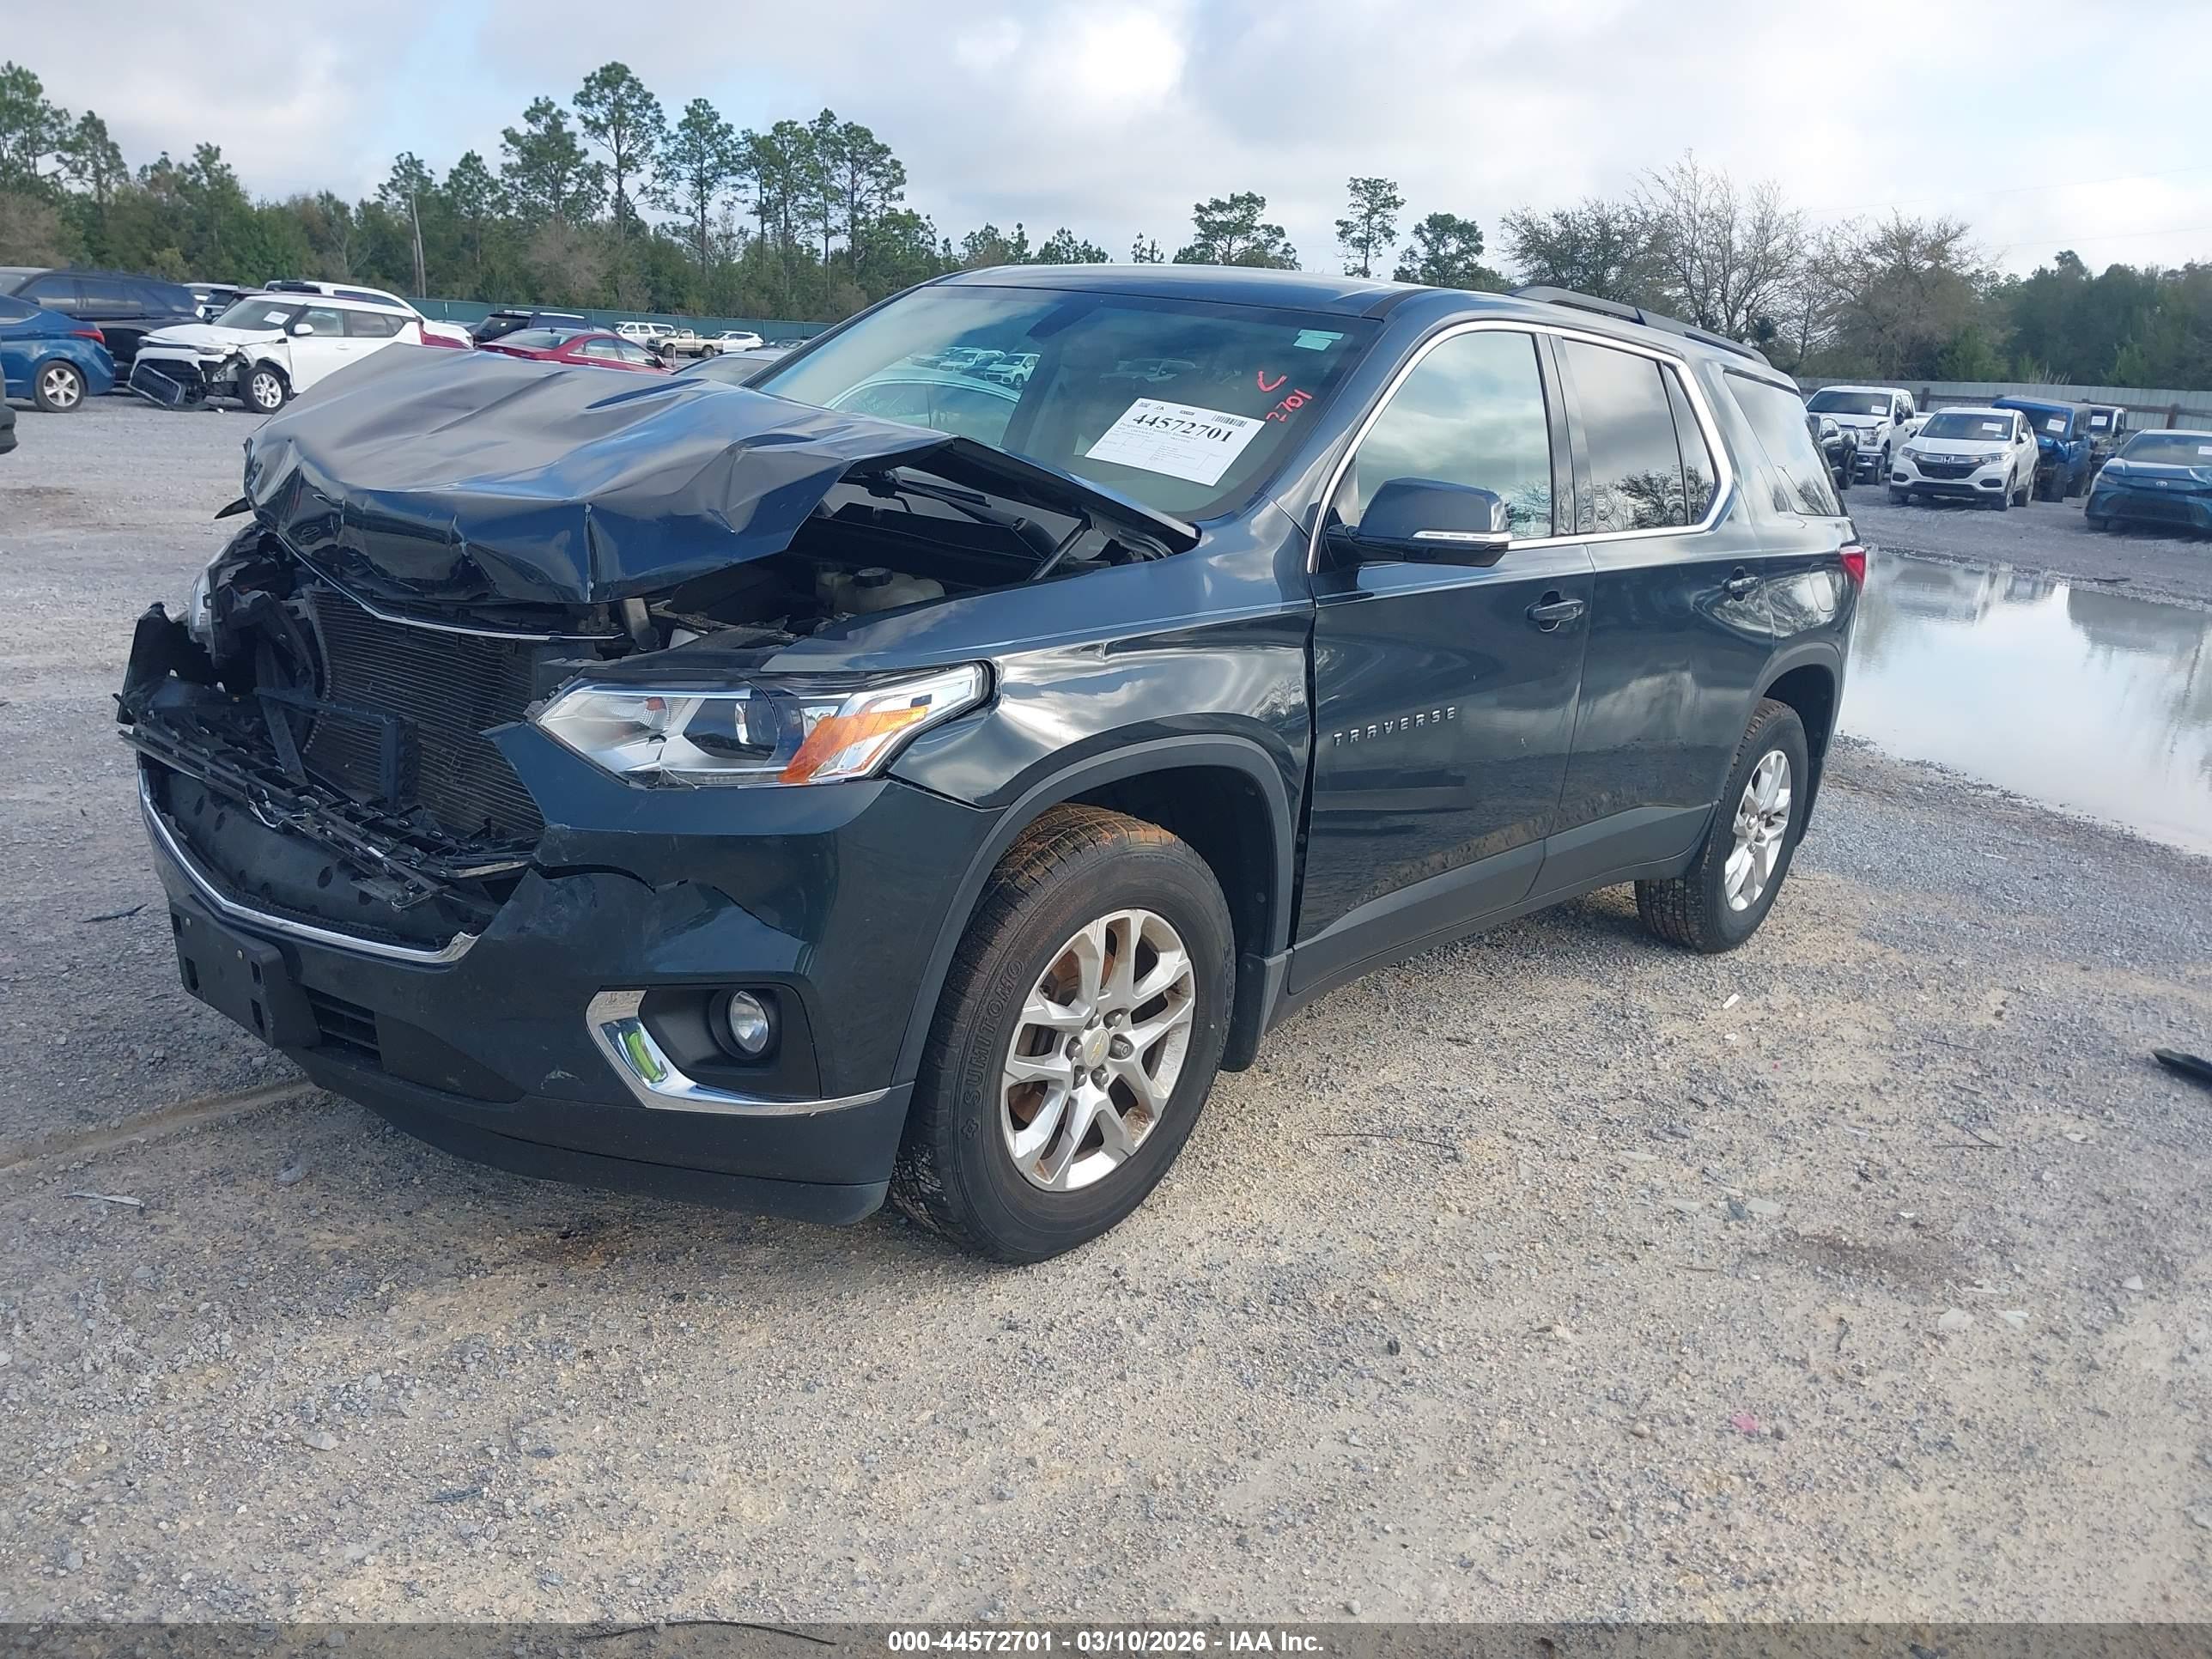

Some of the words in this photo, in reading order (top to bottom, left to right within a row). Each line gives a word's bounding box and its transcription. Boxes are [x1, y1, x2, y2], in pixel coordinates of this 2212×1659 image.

[1266, 389, 1312, 422] 2701
[1133, 414, 1234, 442] 44572701
[1334, 707, 1455, 746] TRAVERSE
[963, 959, 1024, 1107] SUMITOMO
